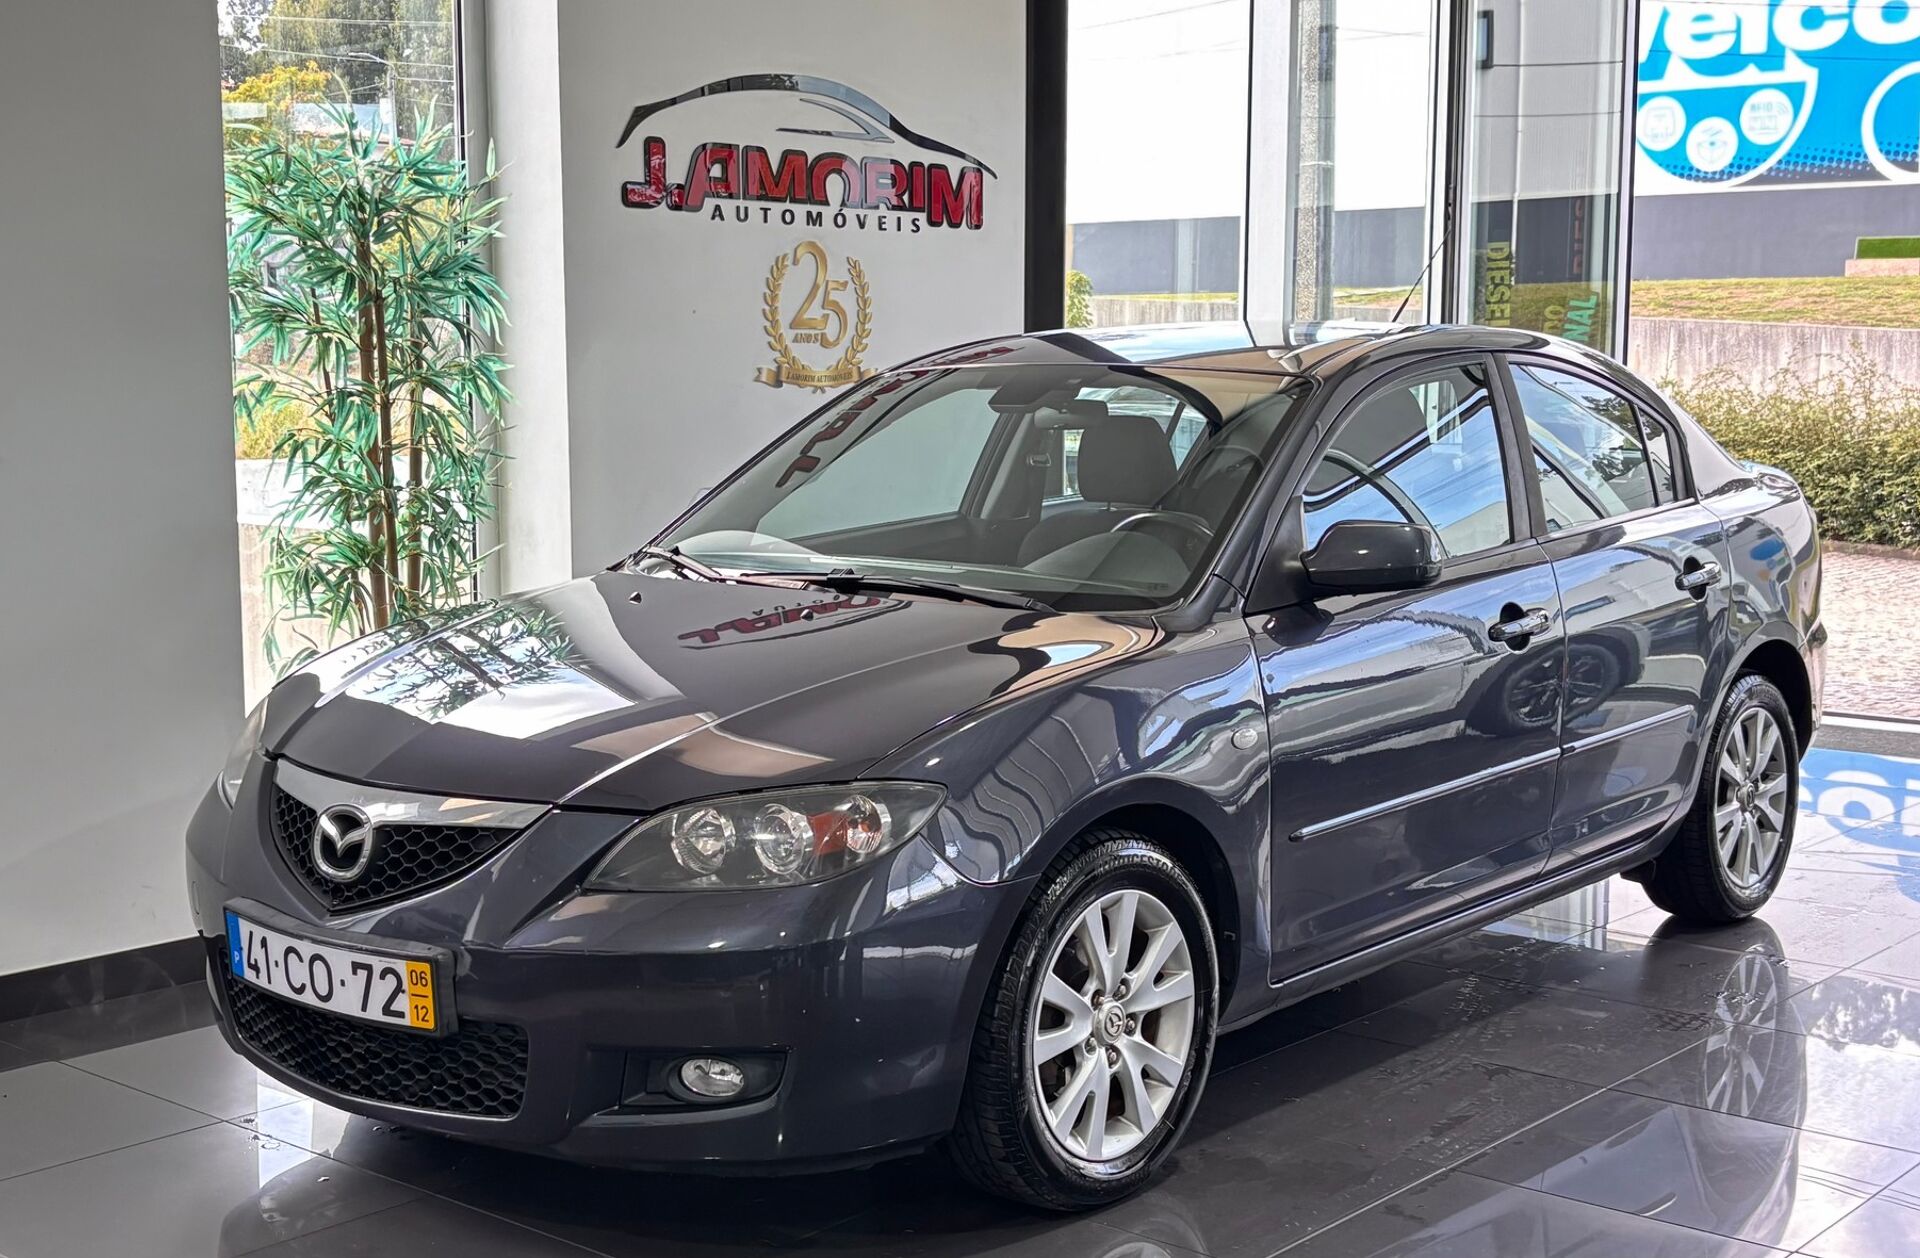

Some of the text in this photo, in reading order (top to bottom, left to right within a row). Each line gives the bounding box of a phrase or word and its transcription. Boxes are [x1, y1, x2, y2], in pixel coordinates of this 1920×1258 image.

[710, 203, 921, 233] AUTOMÓVEIS
[789, 240, 849, 349] 25
[792, 333, 820, 344] ANOS
[234, 950, 240, 964] P
[410, 969, 429, 988] 06
[413, 1003, 430, 1023] 12
